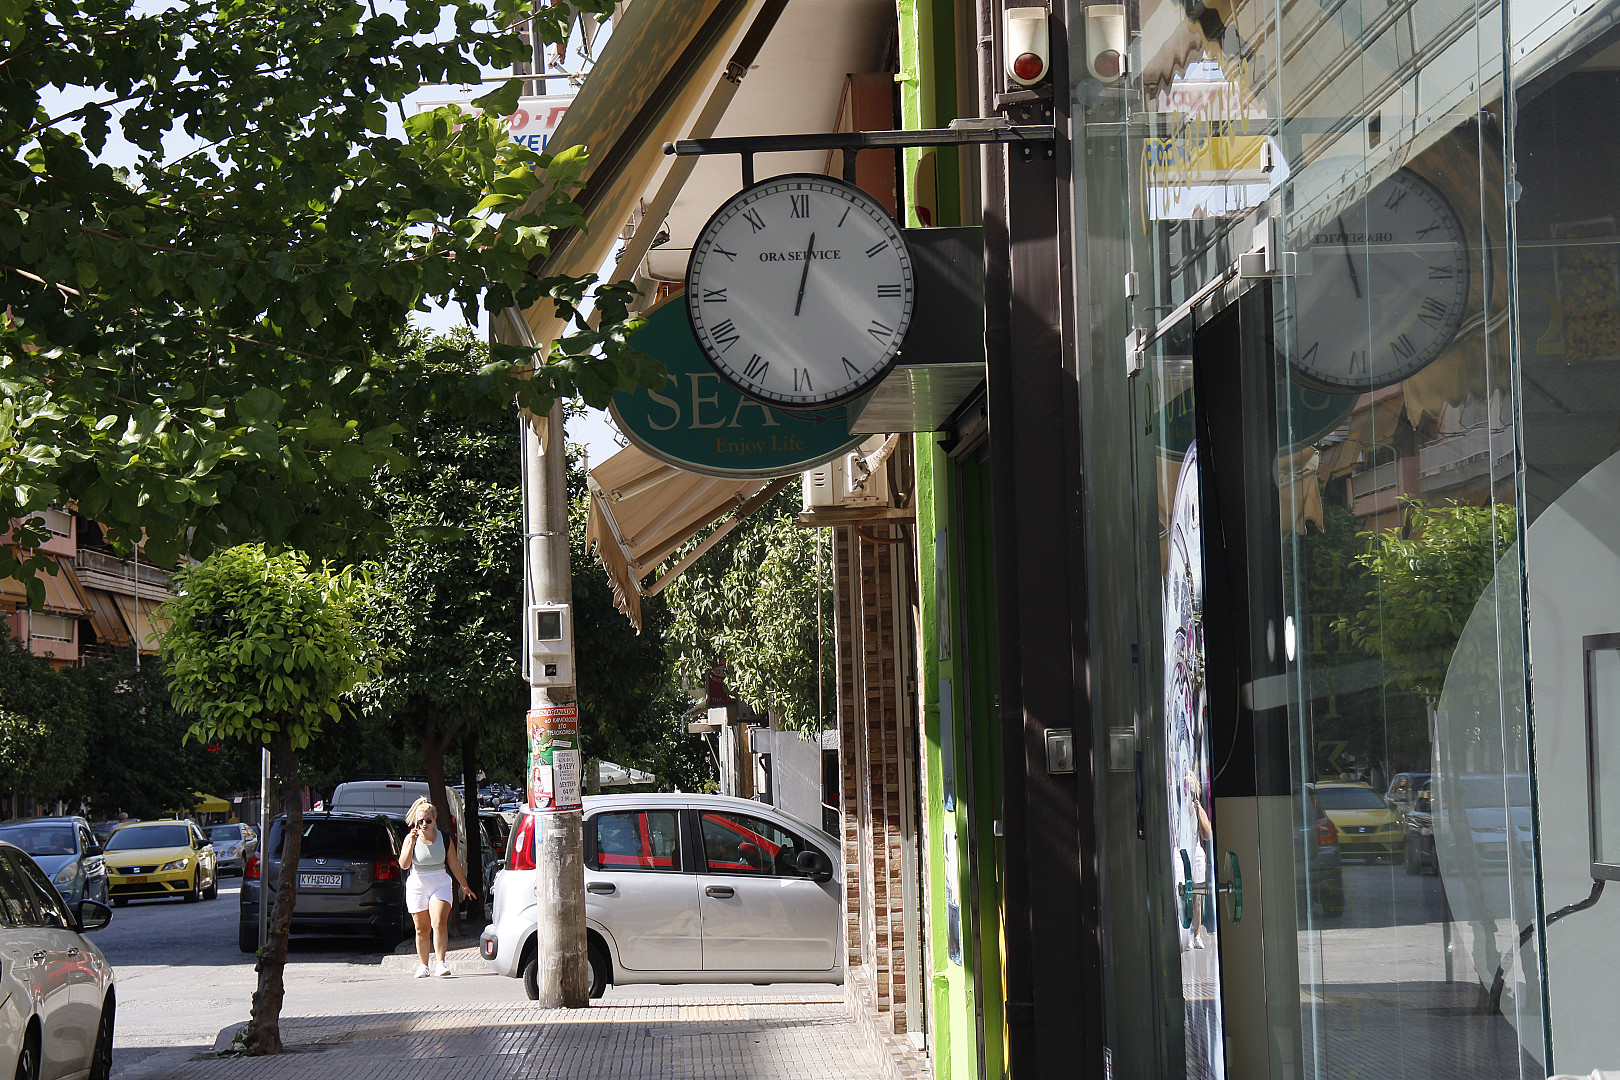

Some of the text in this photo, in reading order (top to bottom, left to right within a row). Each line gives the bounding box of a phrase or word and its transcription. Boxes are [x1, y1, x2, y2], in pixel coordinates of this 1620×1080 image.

[790, 194, 810, 219] XII
[837, 206, 851, 228] I
[742, 207, 767, 234] XI
[712, 243, 737, 262] X
[759, 251, 786, 262] ORA
[865, 240, 889, 258] II
[703, 288, 727, 303] IX
[877, 284, 901, 298] III
[710, 318, 740, 353] VIII
[868, 320, 894, 346] IV
[743, 353, 769, 385] VII
[842, 356, 861, 380] V
[793, 368, 813, 392] VI
[715, 435, 804, 455] Enjoy Life
